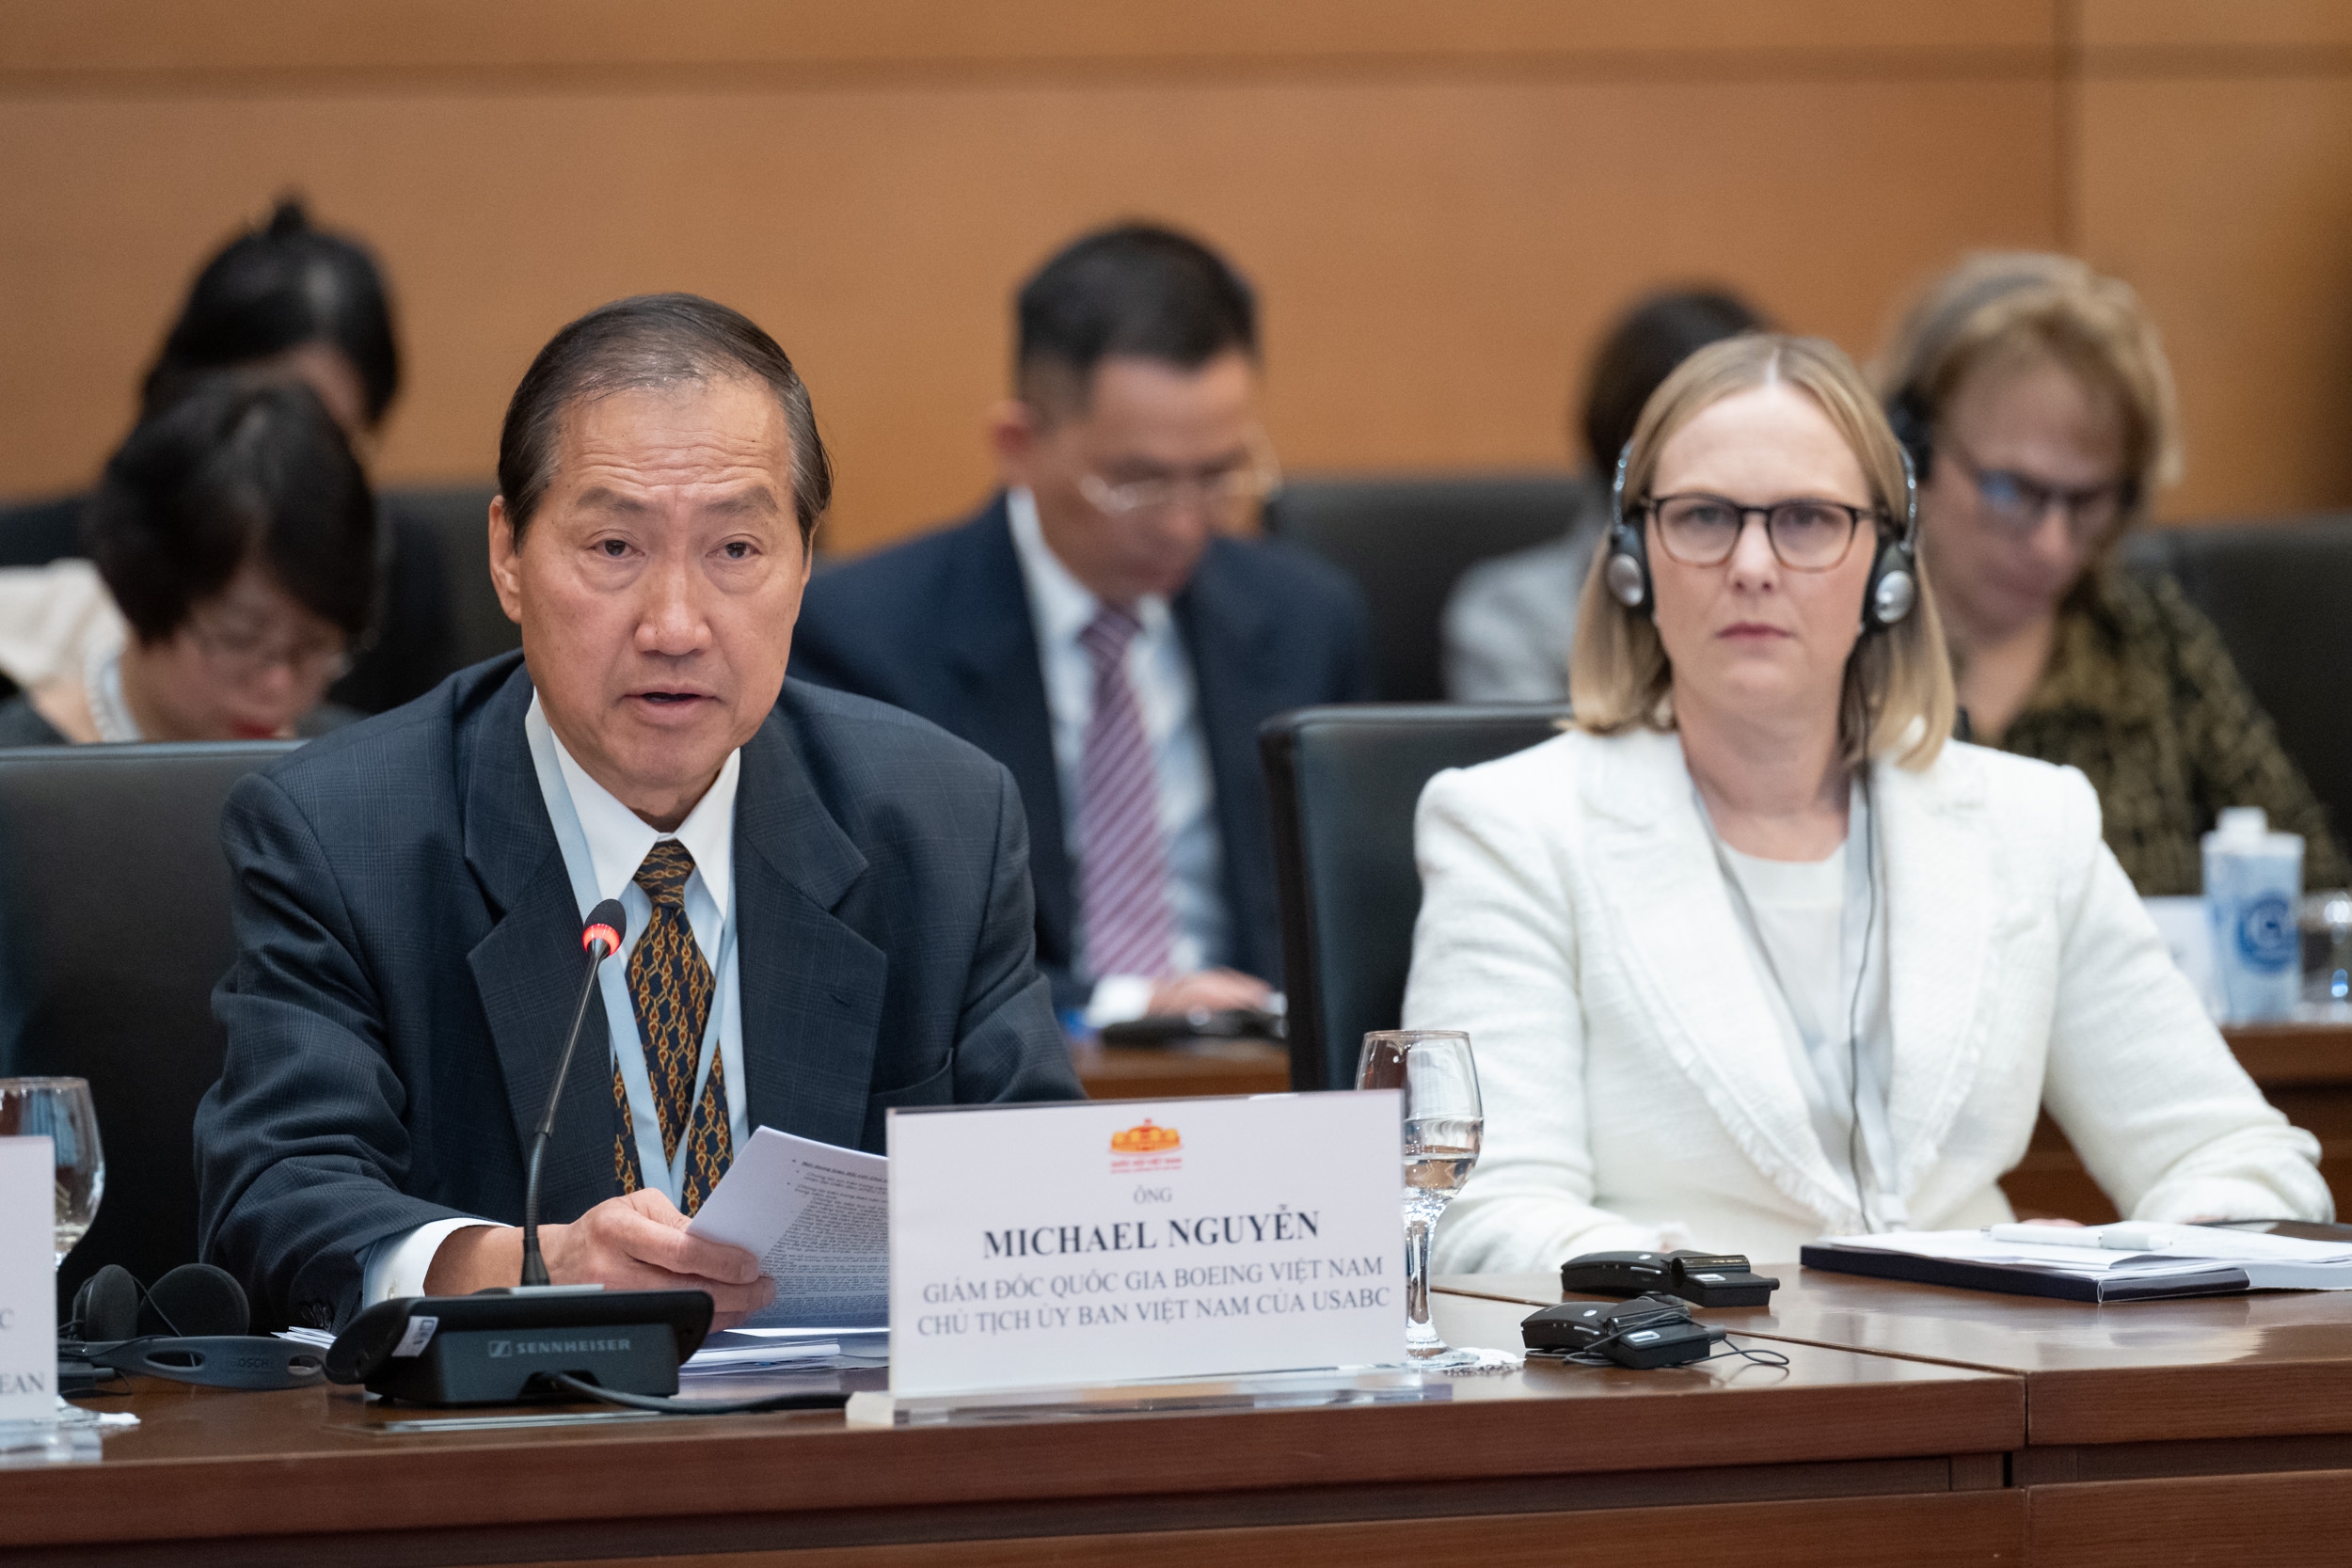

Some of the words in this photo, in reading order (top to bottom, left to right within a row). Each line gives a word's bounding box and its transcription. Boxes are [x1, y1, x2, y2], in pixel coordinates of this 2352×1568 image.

[1133, 1184, 1172, 1204] ÔNG
[984, 1222, 1158, 1259] MICHAEL
[1168, 1204, 1319, 1247] NGUYỄN
[923, 1276, 987, 1304] GIÁM
[994, 1273, 1045, 1299] ĐỐC
[1051, 1269, 1119, 1299] QUỐC
[1125, 1270, 1167, 1291] GIA
[1174, 1263, 1263, 1288] BOEING
[1269, 1258, 1322, 1284] VIỆT
[1328, 1256, 1383, 1278] NAM
[917, 1308, 969, 1337] CHỦ
[975, 1308, 1030, 1336] TỊCH
[1038, 1302, 1071, 1328] ỦY
[1078, 1303, 1128, 1325] BAN
[1136, 1297, 1188, 1324] VIỆT
[1196, 1295, 1249, 1318] NAM
[1256, 1288, 1306, 1315] CỦA
[1312, 1287, 1391, 1311] USABC
[517, 1338, 631, 1354] SENNHEISER
